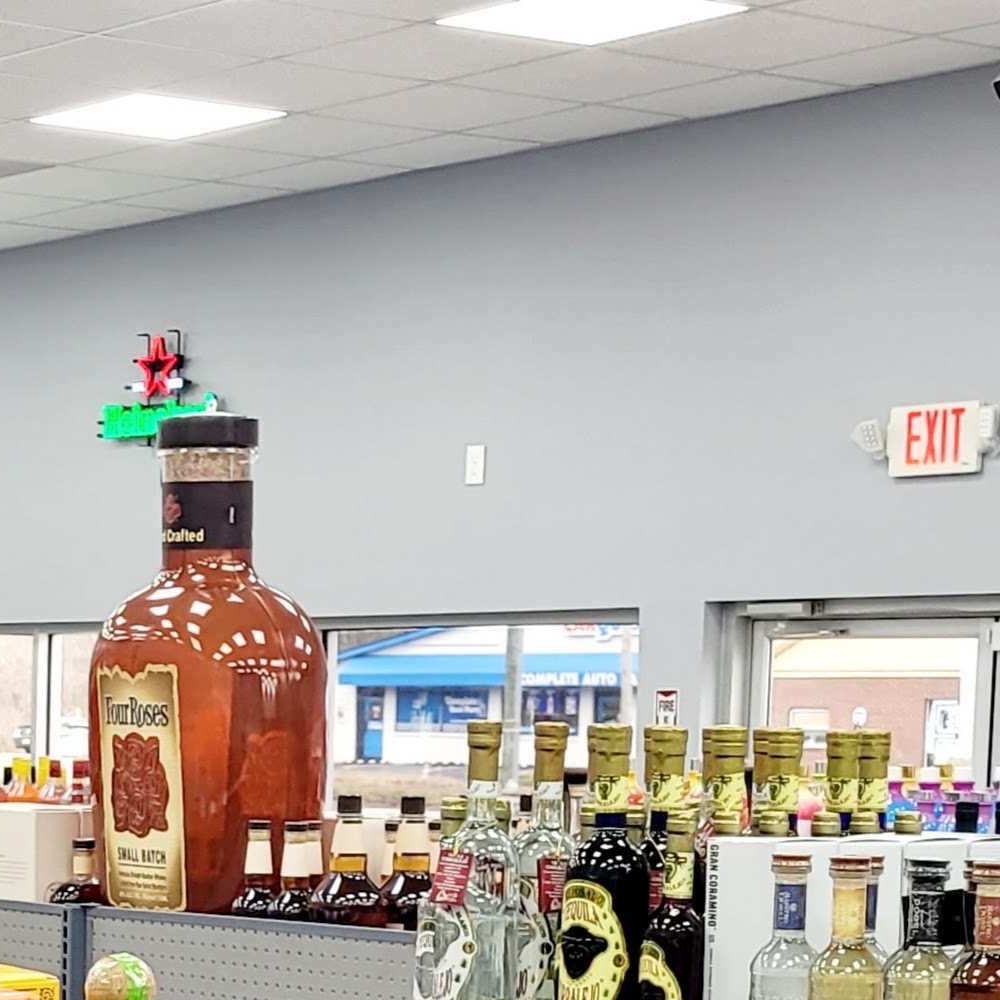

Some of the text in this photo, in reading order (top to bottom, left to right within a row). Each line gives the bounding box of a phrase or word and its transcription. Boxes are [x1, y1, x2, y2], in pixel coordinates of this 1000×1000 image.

[906, 408, 965, 465] EXIT
[167, 528, 204, 543] Crafted
[583, 673, 617, 685] AUTO
[106, 697, 168, 727] Four Roses
[659, 700, 674, 712] FIRE
[118, 847, 166, 865] SMALL BATCH
[709, 844, 719, 871] GRAN
[707, 874, 718, 927] CORAMINO
